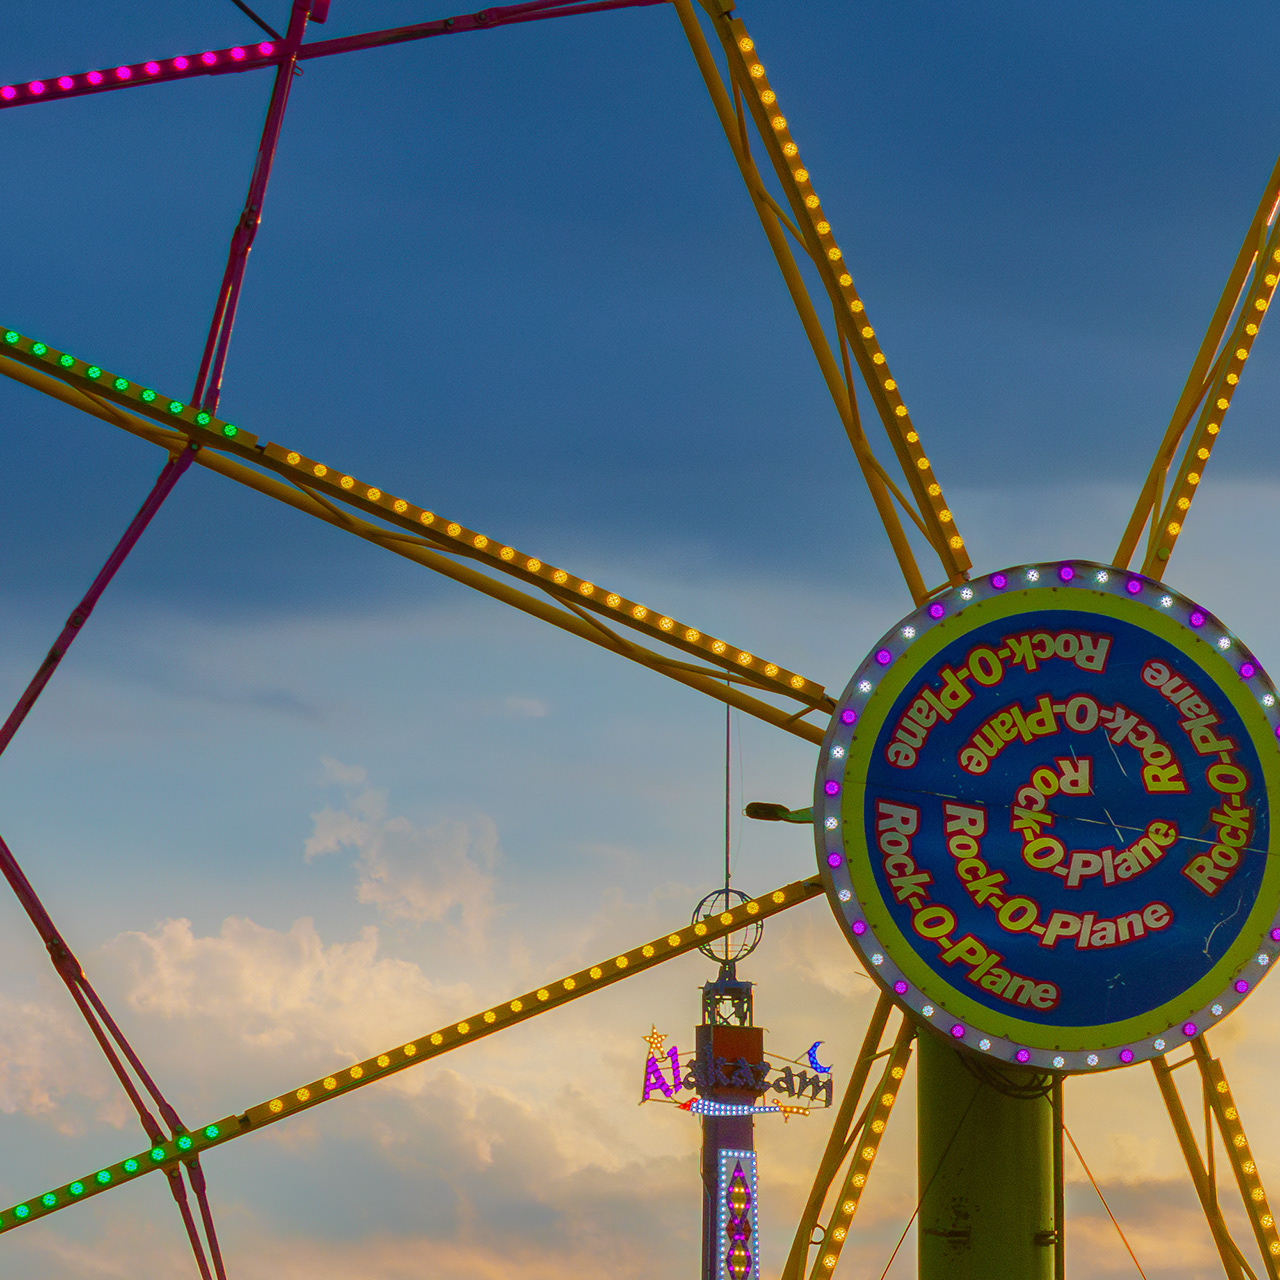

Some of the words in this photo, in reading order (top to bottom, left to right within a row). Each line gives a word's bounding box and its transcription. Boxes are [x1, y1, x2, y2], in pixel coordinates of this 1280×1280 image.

[884, 632, 1112, 768] Rock-O-Plane
[958, 696, 1186, 794] Rock-O-Plane
[1011, 757, 1178, 887] Rock-O-Plane
[1142, 661, 1251, 896] Rock-O-Plane
[876, 800, 1060, 1010] Rock-O-Plane
[944, 801, 1173, 949] Rock-O-Plane
